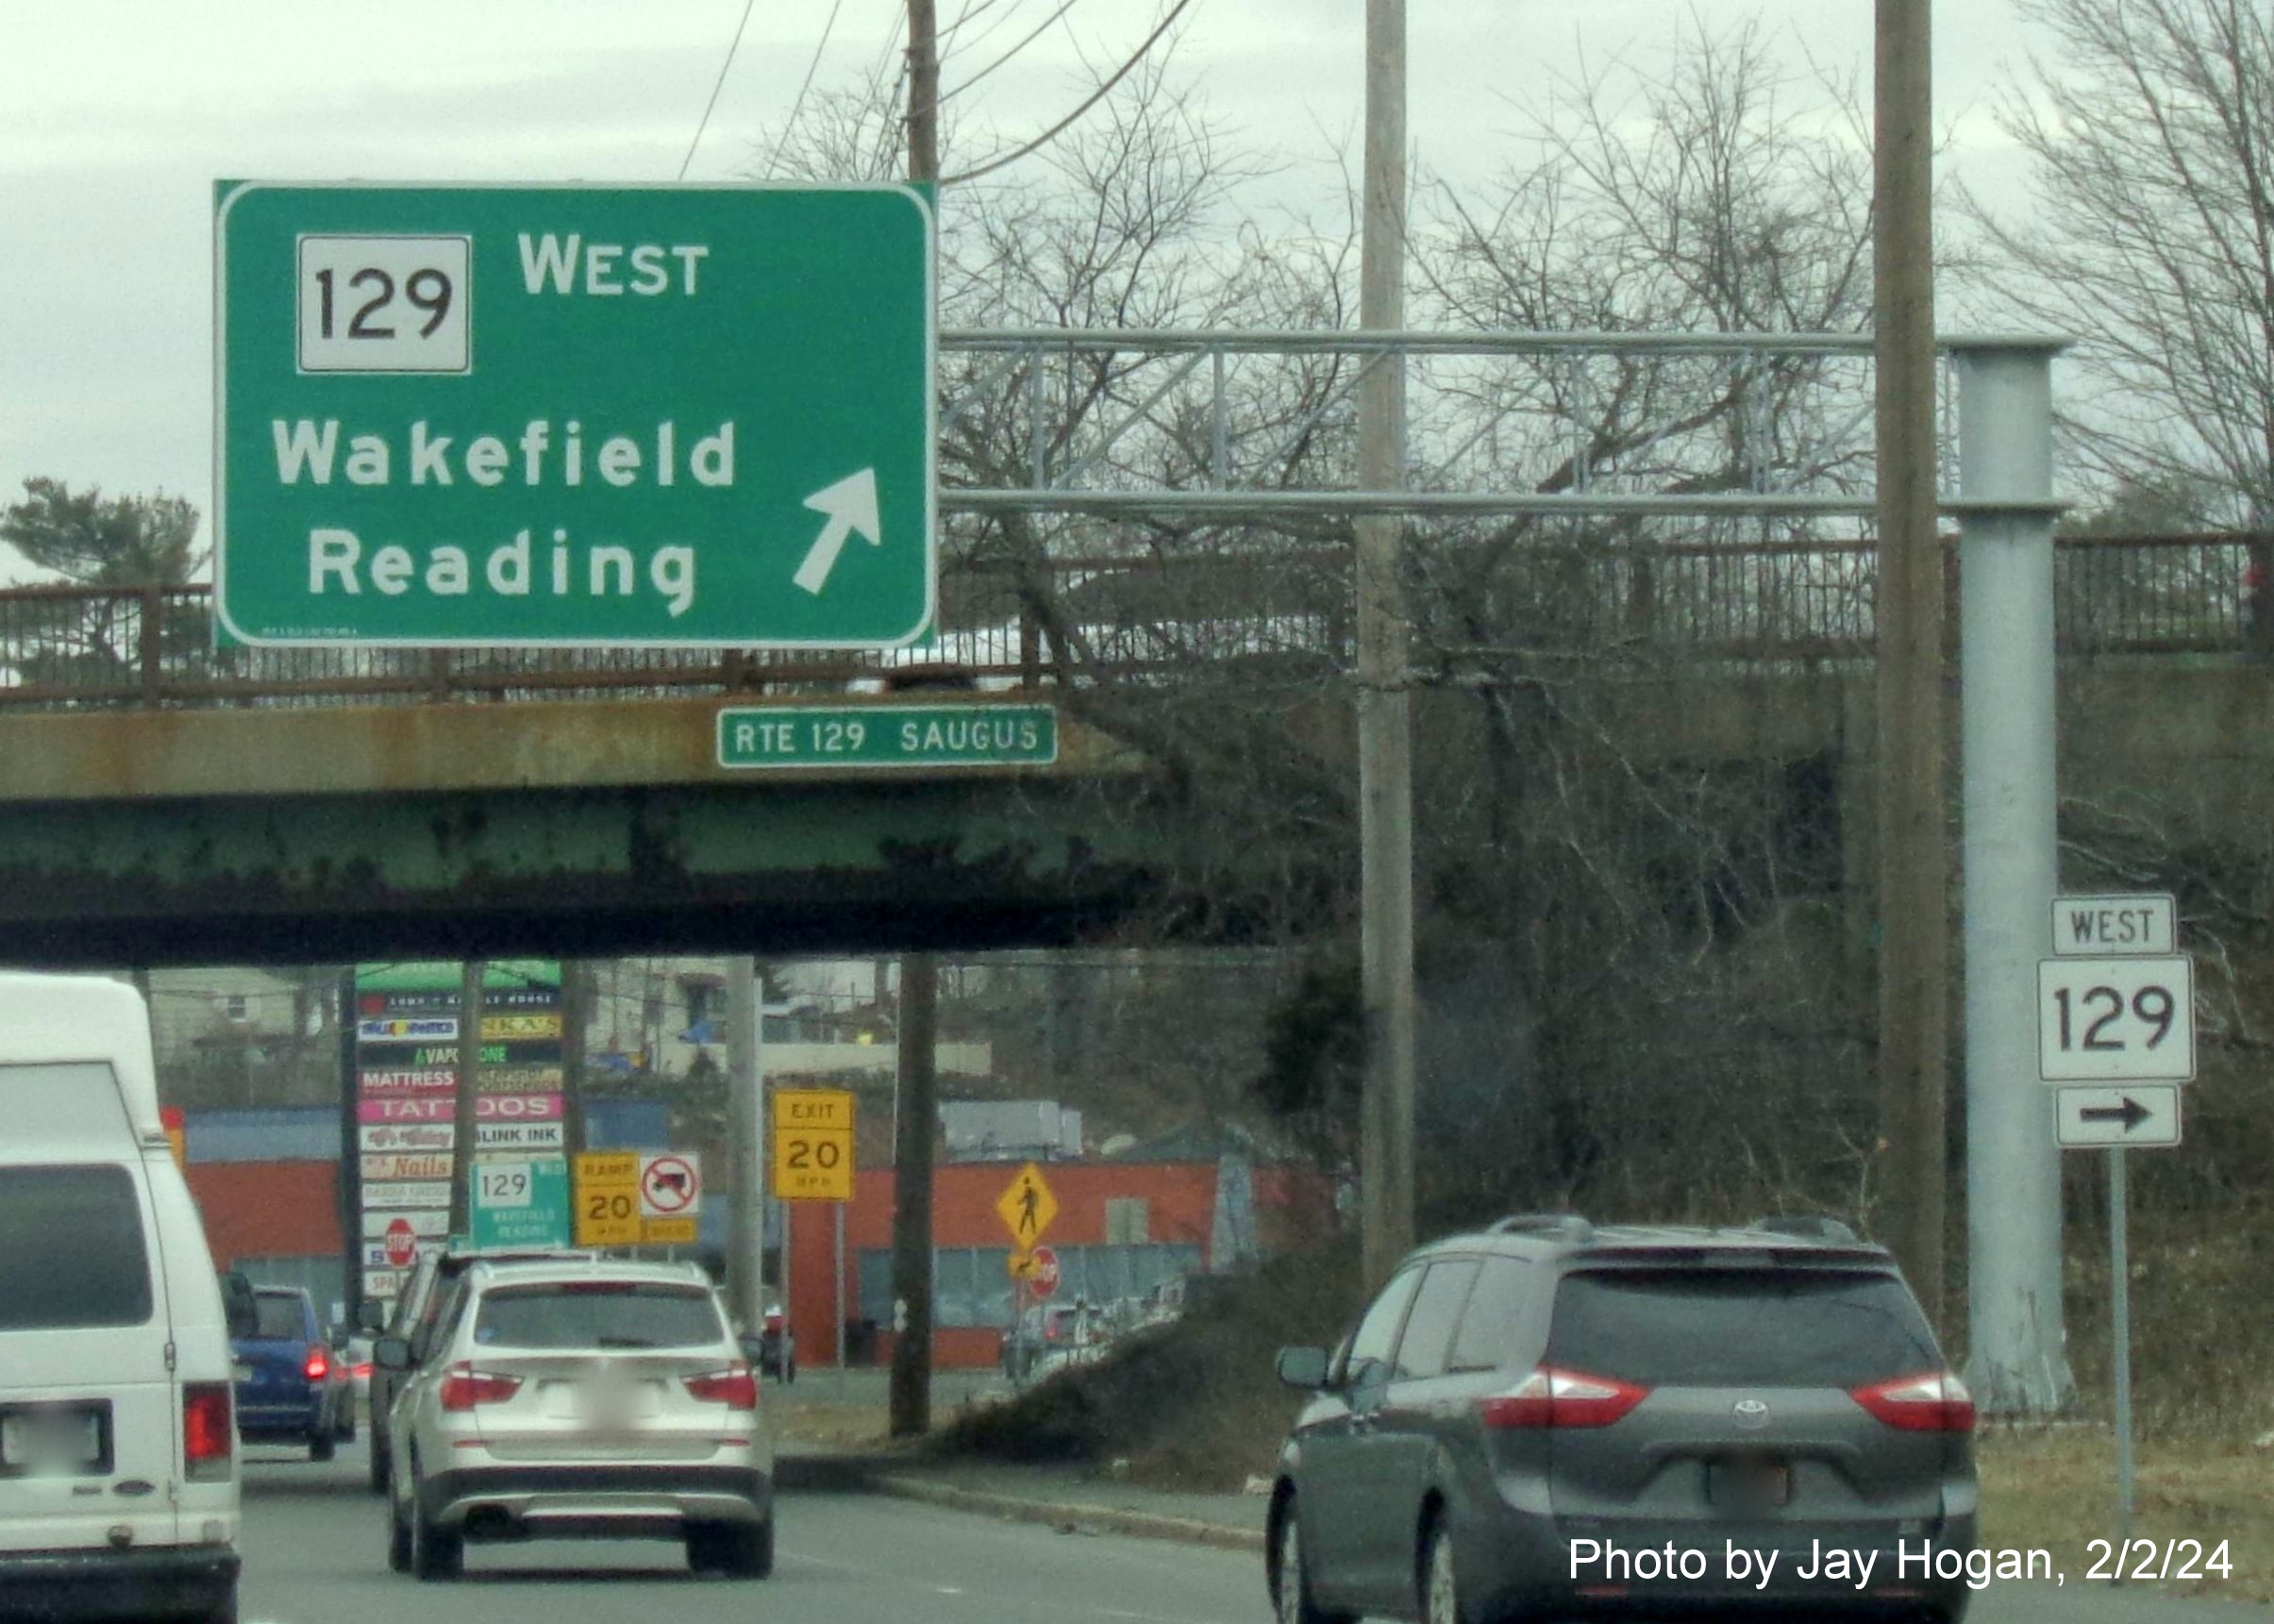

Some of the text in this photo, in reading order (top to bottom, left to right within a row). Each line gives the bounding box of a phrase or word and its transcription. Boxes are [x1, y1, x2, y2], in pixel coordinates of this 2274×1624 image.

[518, 232, 709, 295] WEST
[316, 267, 454, 341] 129
[271, 418, 736, 486] Wakefield
[309, 528, 696, 617] Reading
[736, 720, 1038, 753] RTE 129 SAUGUS
[2070, 909, 2154, 943] WEST
[2053, 985, 2176, 1052] 129
[363, 1071, 455, 1087] MATTRESS
[792, 1103, 835, 1119] EXIT
[527, 1129, 557, 1141] INK
[395, 1158, 447, 1176] Nails
[788, 1140, 840, 1169] 20
[482, 1174, 527, 1197] 129
[589, 1196, 631, 1220] 20
[387, 1233, 413, 1252] STOP
